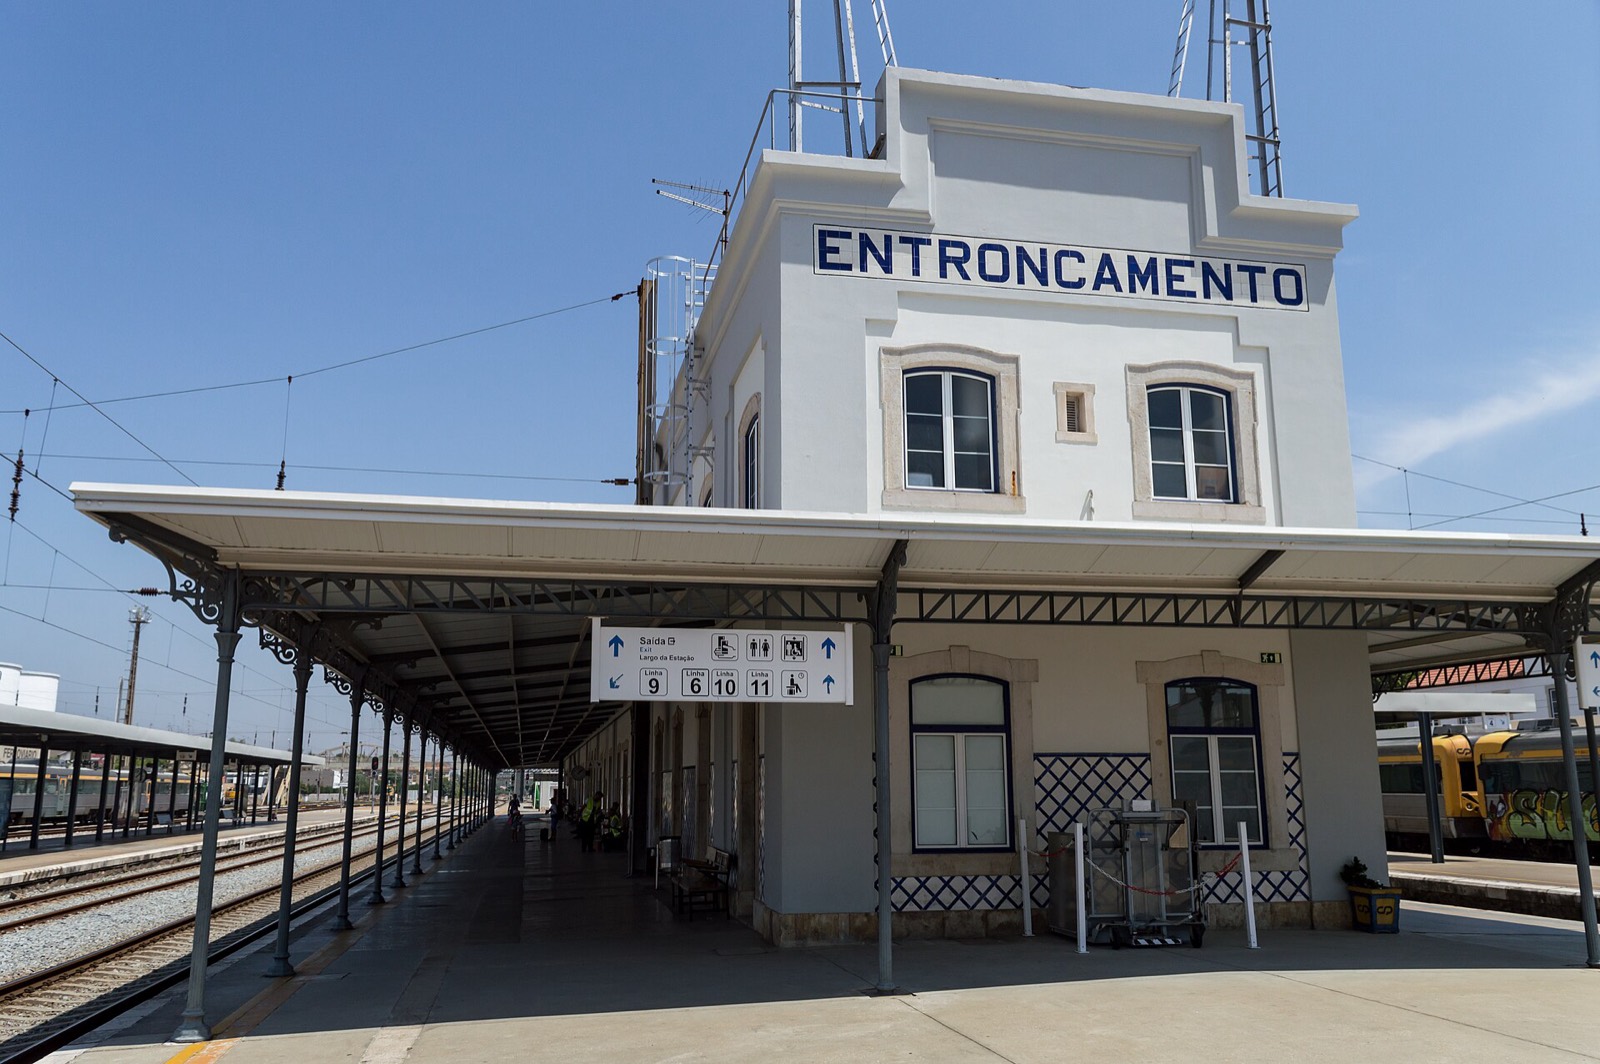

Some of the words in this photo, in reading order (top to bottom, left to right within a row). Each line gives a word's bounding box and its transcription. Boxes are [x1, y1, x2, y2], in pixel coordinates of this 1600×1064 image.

[817, 228, 1305, 306] ENTRONCAMENTO
[639, 636, 666, 646] Saída
[639, 654, 659, 662] Largo
[668, 654, 695, 662] Estação
[648, 677, 660, 695] 9
[690, 677, 702, 695] 6
[714, 679, 736, 696] 10
[750, 679, 769, 696] 11
